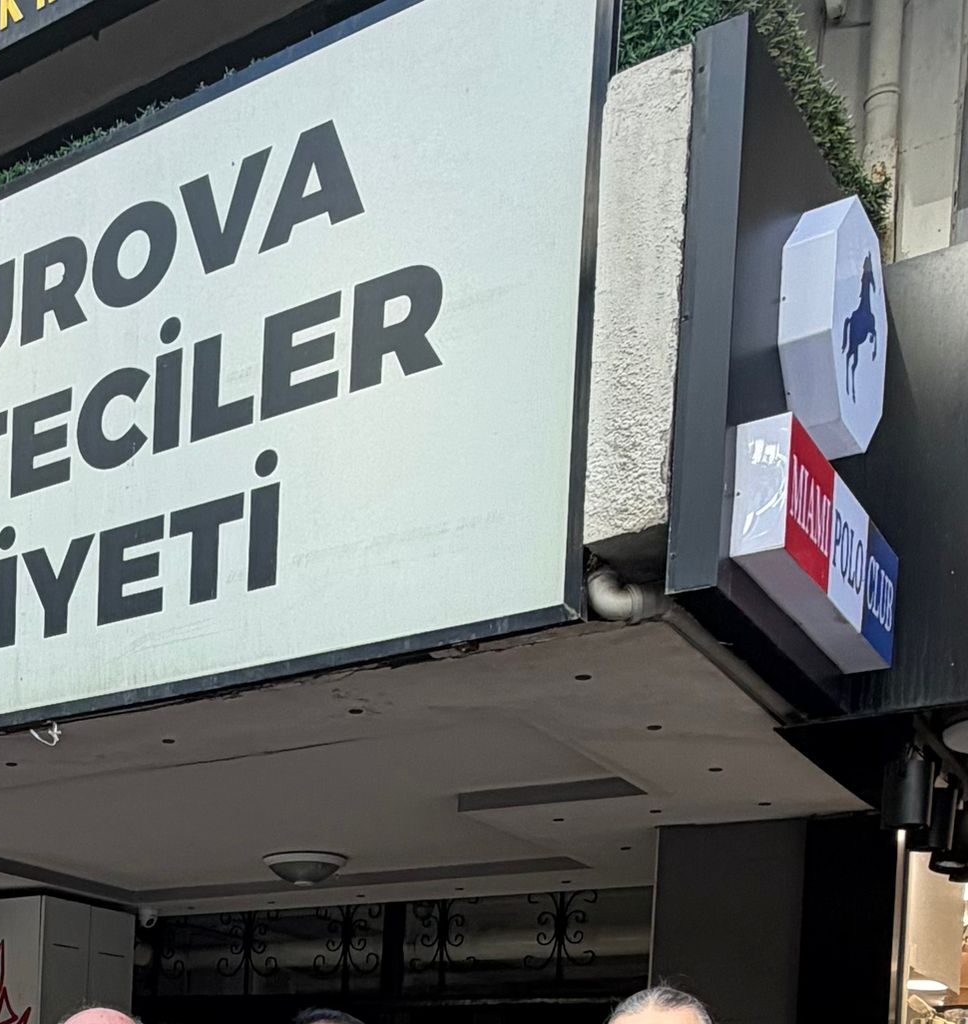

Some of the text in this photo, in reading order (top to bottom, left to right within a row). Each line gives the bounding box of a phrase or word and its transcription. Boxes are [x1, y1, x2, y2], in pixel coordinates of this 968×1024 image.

[789, 453, 832, 558] MIAMI
[832, 508, 865, 595] POLO
[866, 555, 894, 632] CLUB
